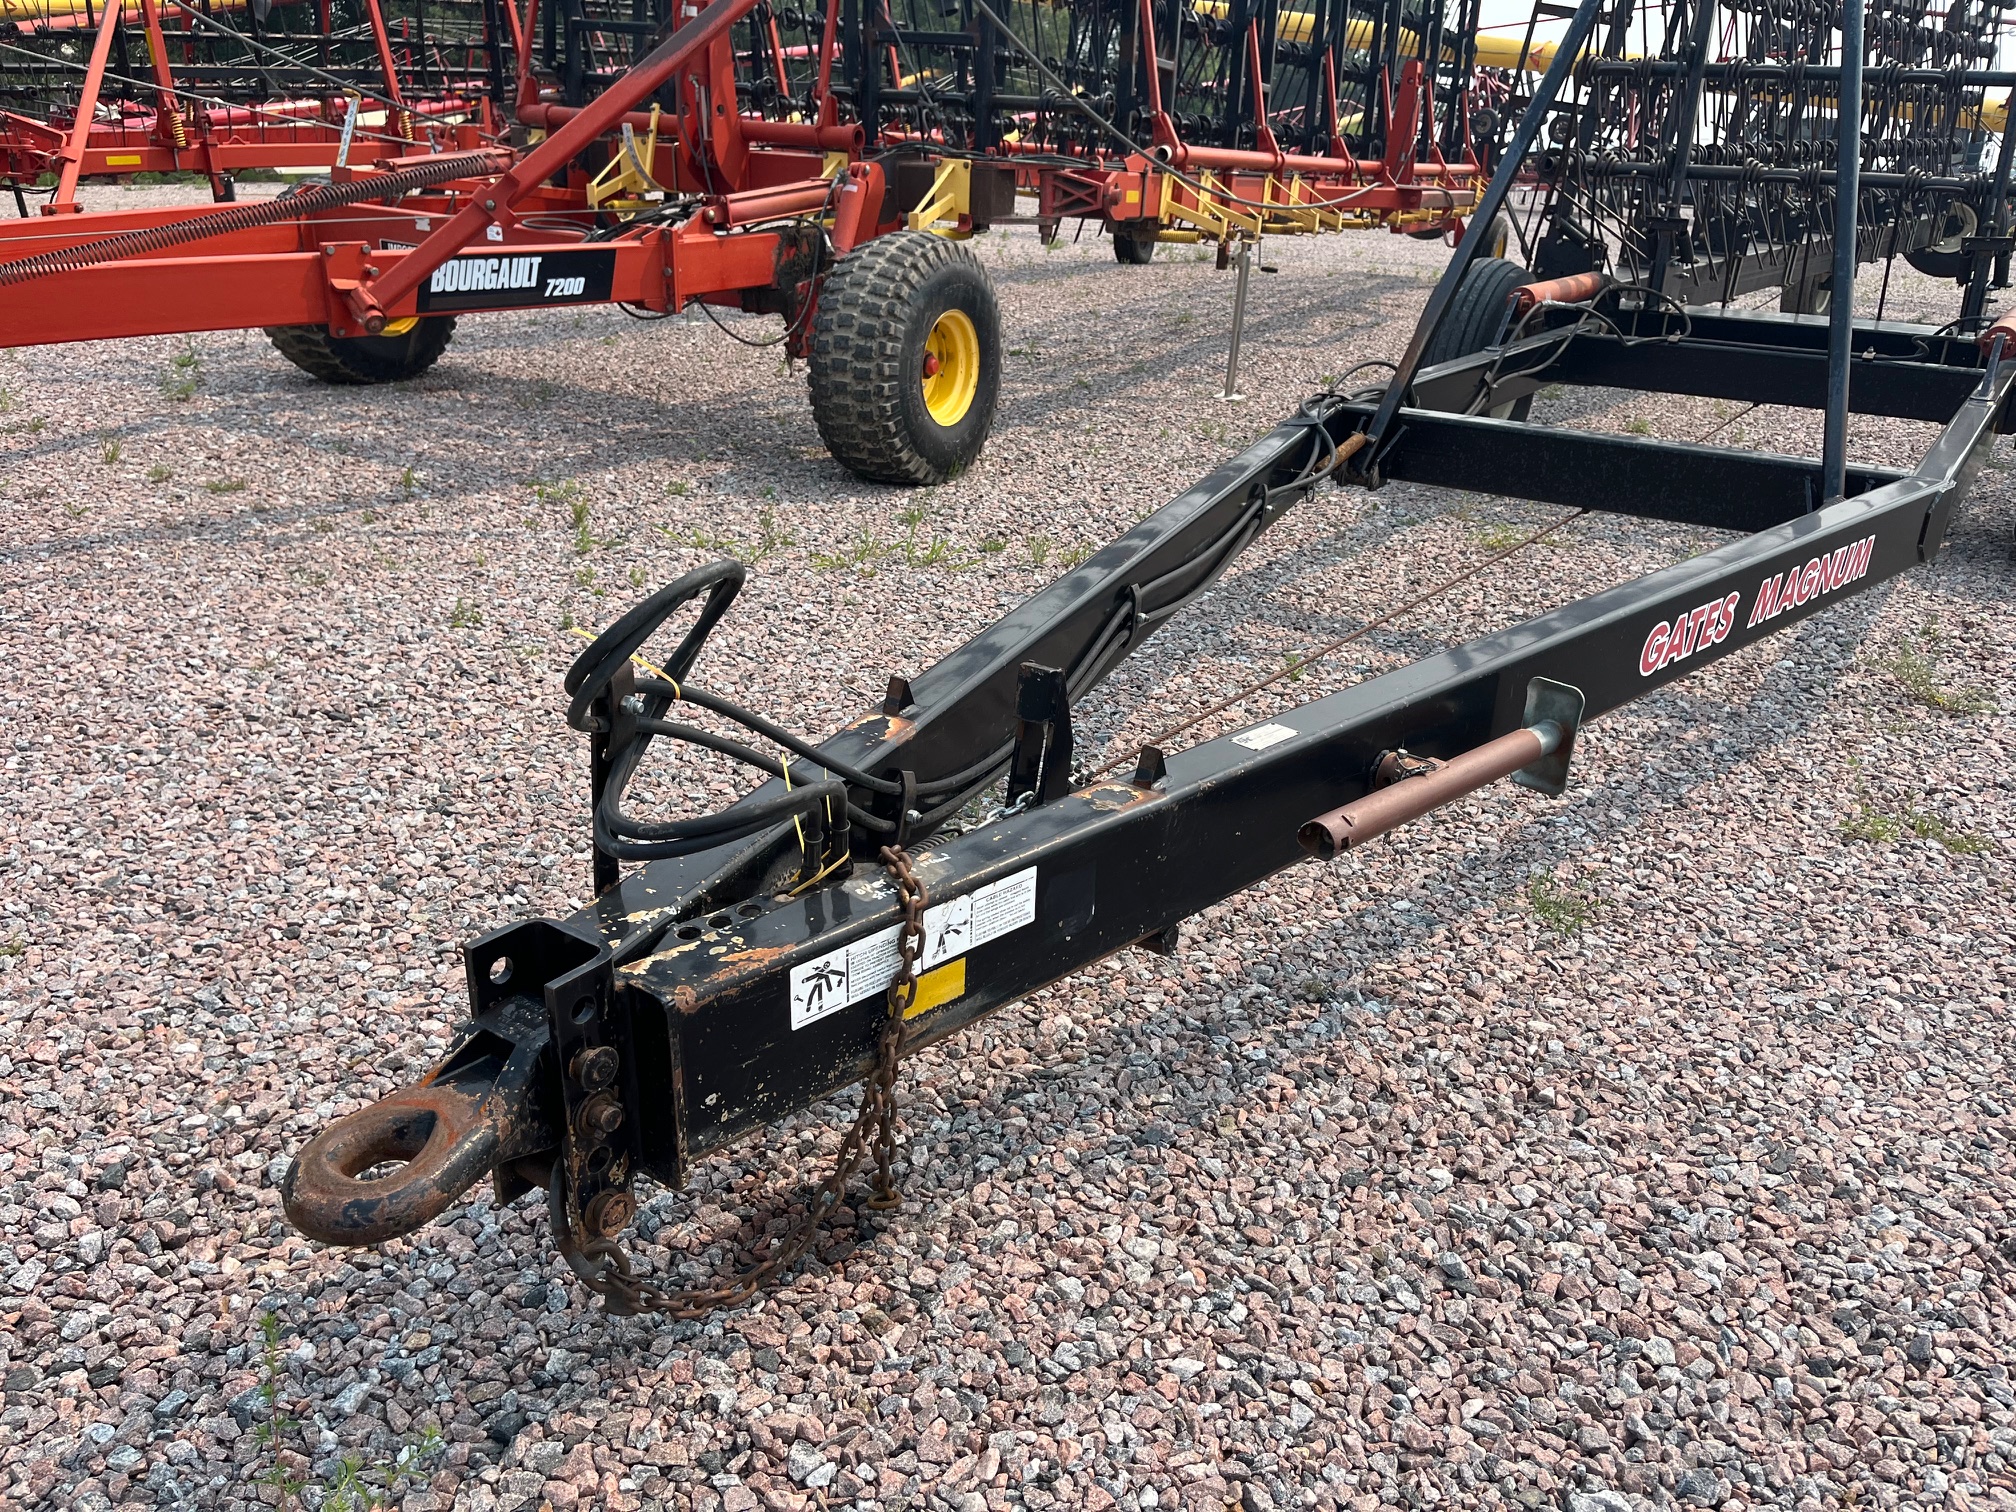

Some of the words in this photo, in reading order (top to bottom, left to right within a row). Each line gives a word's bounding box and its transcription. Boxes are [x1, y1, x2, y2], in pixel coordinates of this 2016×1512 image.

[430, 257, 542, 293] BOURGAULT
[544, 277, 586, 298] 7200
[1639, 591, 1740, 677] GATES
[1747, 534, 1876, 629] MAGNUM
[985, 892, 1002, 902] CABLE
[850, 951, 867, 961] HITCH
